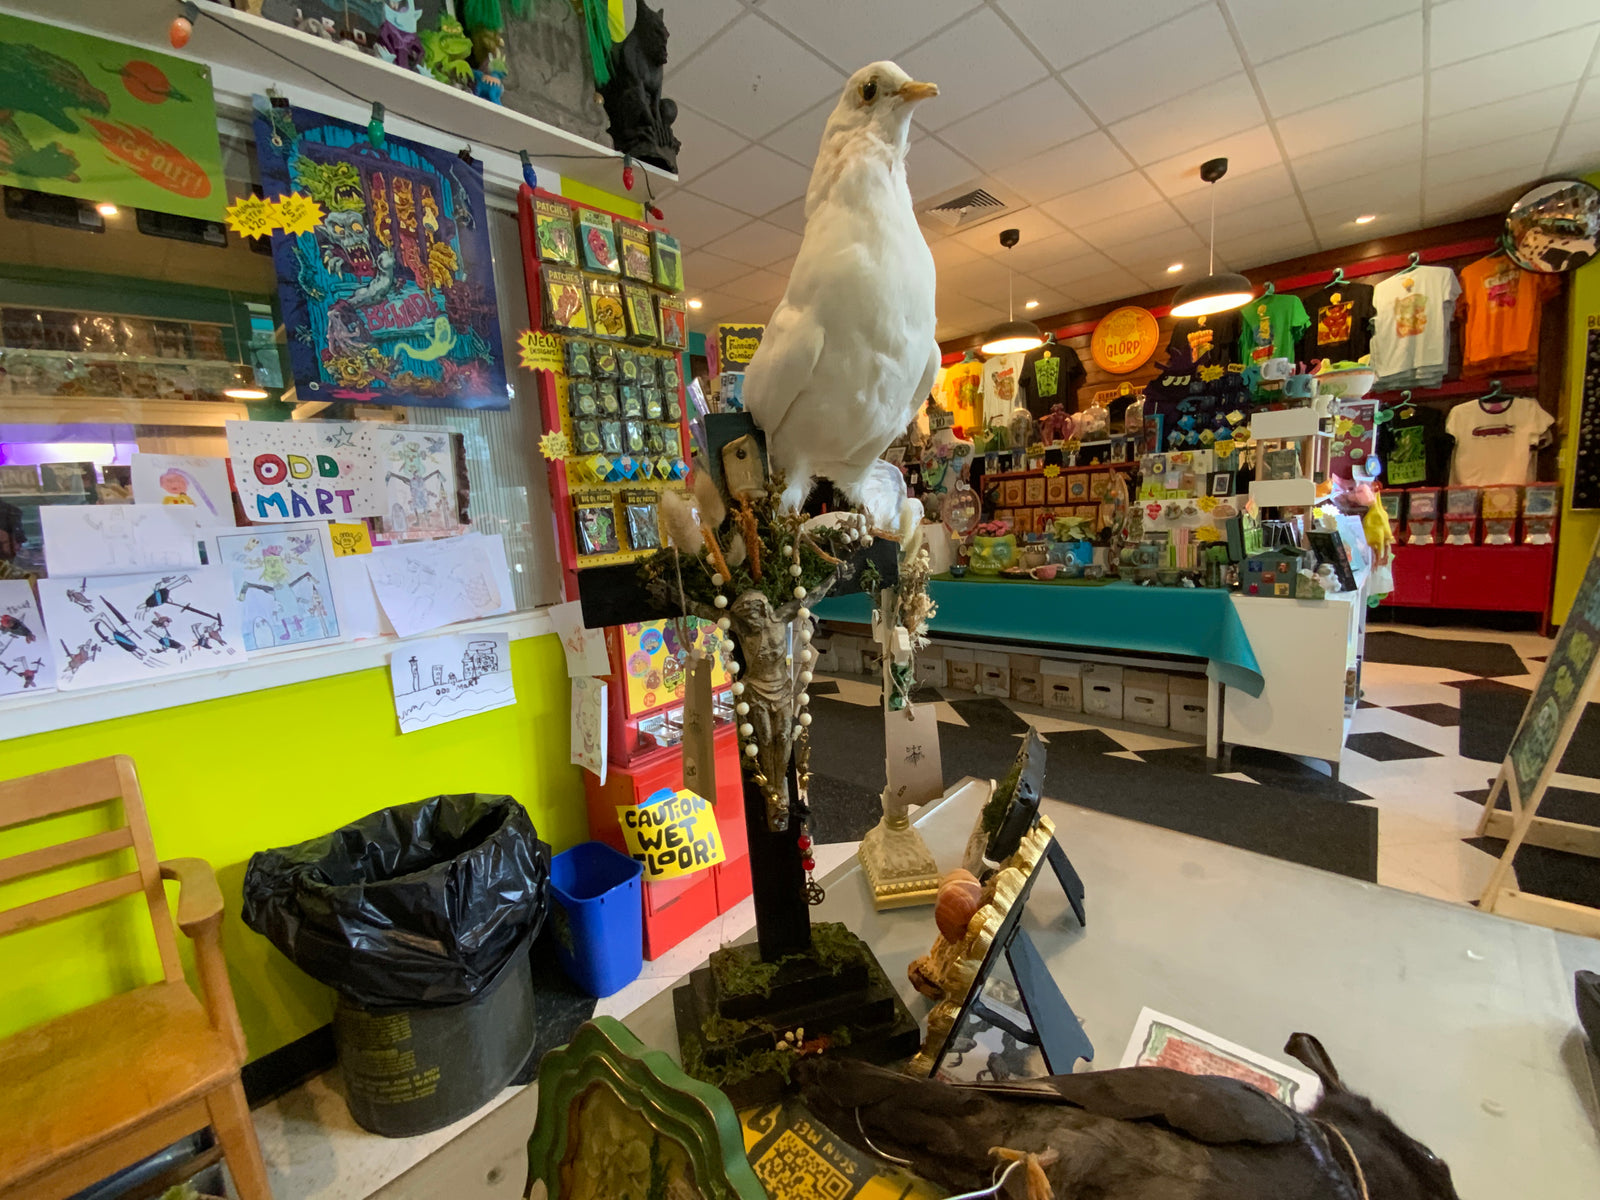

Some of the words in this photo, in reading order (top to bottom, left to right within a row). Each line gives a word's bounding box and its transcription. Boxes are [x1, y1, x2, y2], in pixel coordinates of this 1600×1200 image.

[536, 200, 568, 217] PATCHES
[622, 226, 649, 242] PATCHES
[548, 270, 580, 284] PATCHES
[253, 453, 340, 486] ODD
[256, 488, 355, 518] MART
[637, 816, 698, 851] WET
[793, 1119, 823, 1145] ME!
[822, 1142, 859, 1175] SCAN
